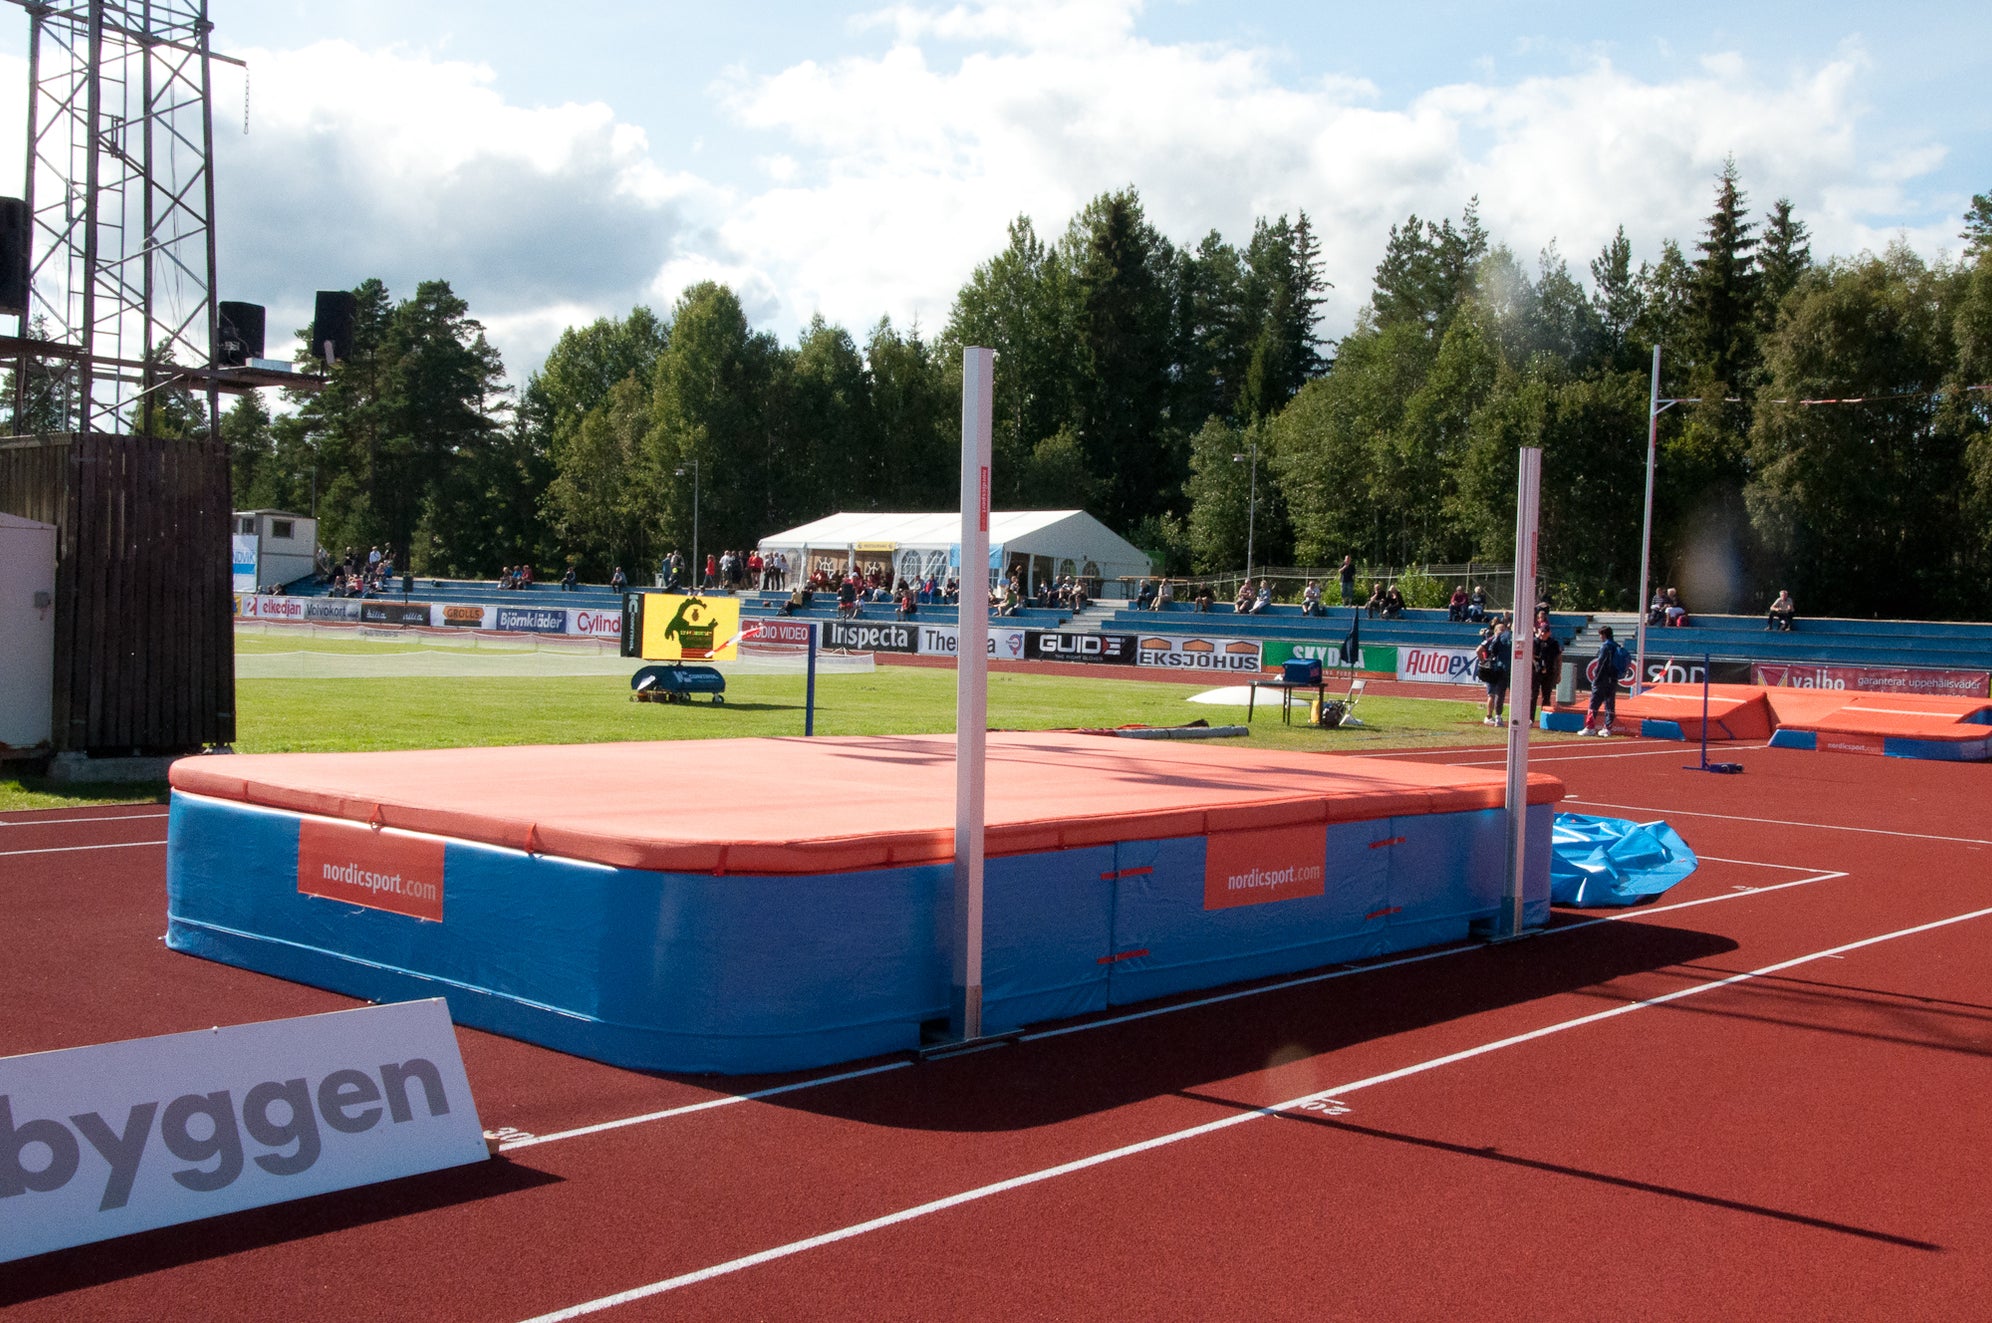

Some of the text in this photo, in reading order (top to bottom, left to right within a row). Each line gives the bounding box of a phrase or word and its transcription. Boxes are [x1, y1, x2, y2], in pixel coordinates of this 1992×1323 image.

[262, 598, 302, 616] elkedjan
[306, 604, 346, 617] Volvokort
[447, 608, 480, 619] GROLLS
[500, 611, 562, 629] Björnkläder
[779, 626, 808, 641] VIDEO
[831, 623, 908, 649] Inspecta
[1040, 634, 1121, 656] GUIDE
[1140, 651, 1259, 670] EKSJÖHUS
[1292, 645, 1366, 669] SKYDA
[1792, 669, 1846, 691] valbo
[1857, 677, 1906, 687] garanterat
[323, 862, 437, 901] nordicsport.com
[1228, 866, 1321, 890] nordicsport.com
[0, 1058, 450, 1213] byggen
